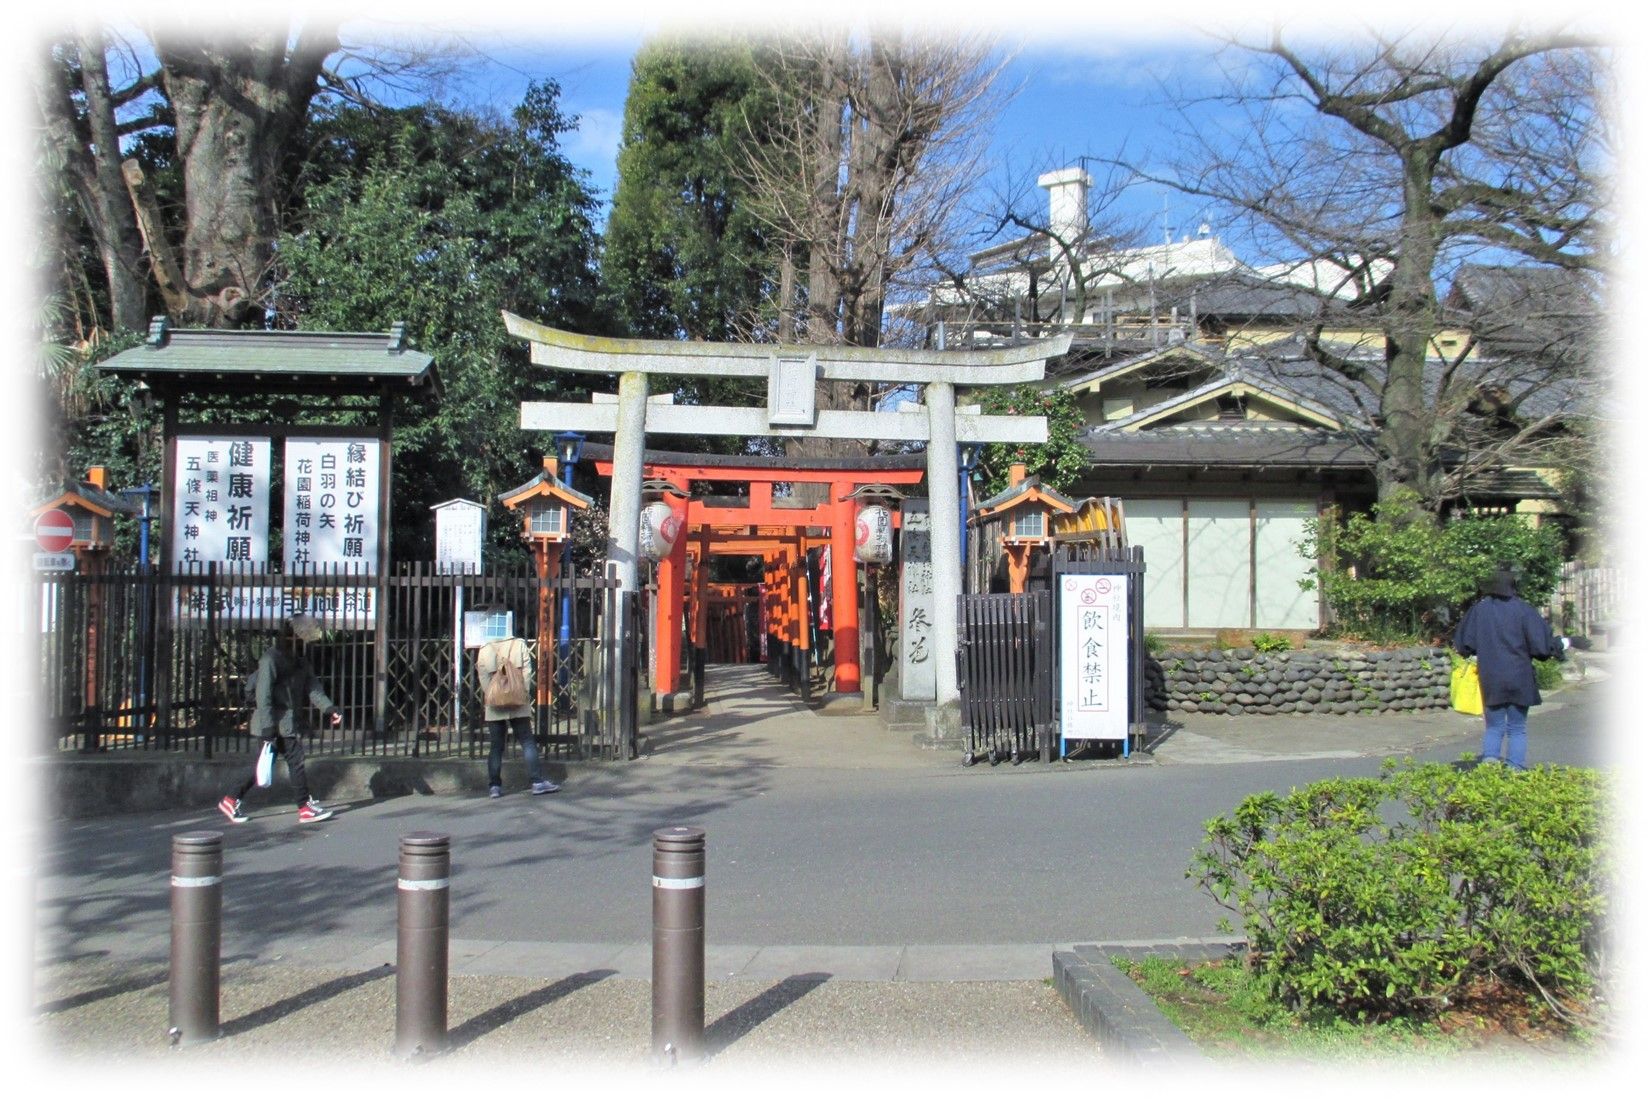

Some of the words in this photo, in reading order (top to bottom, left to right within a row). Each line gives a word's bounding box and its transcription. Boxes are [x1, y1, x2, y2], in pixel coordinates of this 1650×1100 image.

[205, 450, 219, 522] 医薬祖神
[226, 441, 254, 561] 健康祈願
[295, 459, 313, 564] 花園稲荷神社
[320, 453, 336, 529] 白羽の矢
[343, 444, 367, 557] 縁結び祈願
[1081, 610, 1104, 707] 飲食禁止
